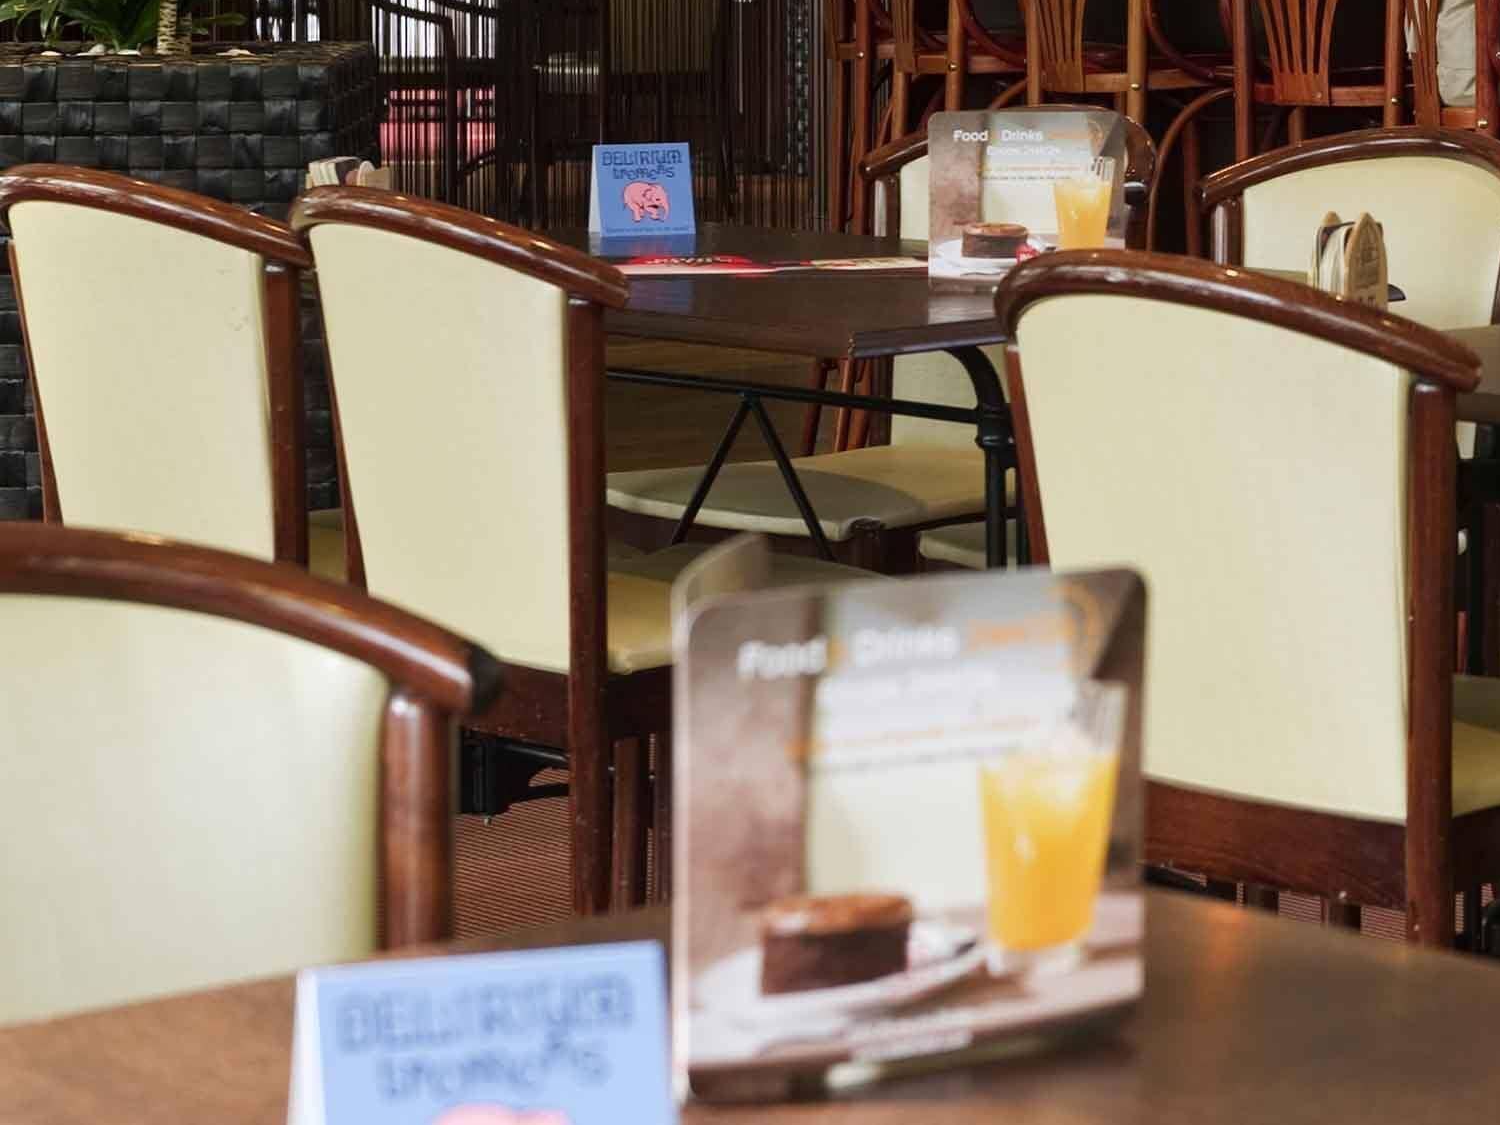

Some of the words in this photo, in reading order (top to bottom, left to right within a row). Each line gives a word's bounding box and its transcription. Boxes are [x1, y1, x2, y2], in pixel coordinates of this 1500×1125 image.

[953, 129, 989, 142] Food
[1001, 129, 1043, 142] Drinks
[601, 149, 682, 166] DELIRIUM
[737, 639, 828, 680] Food
